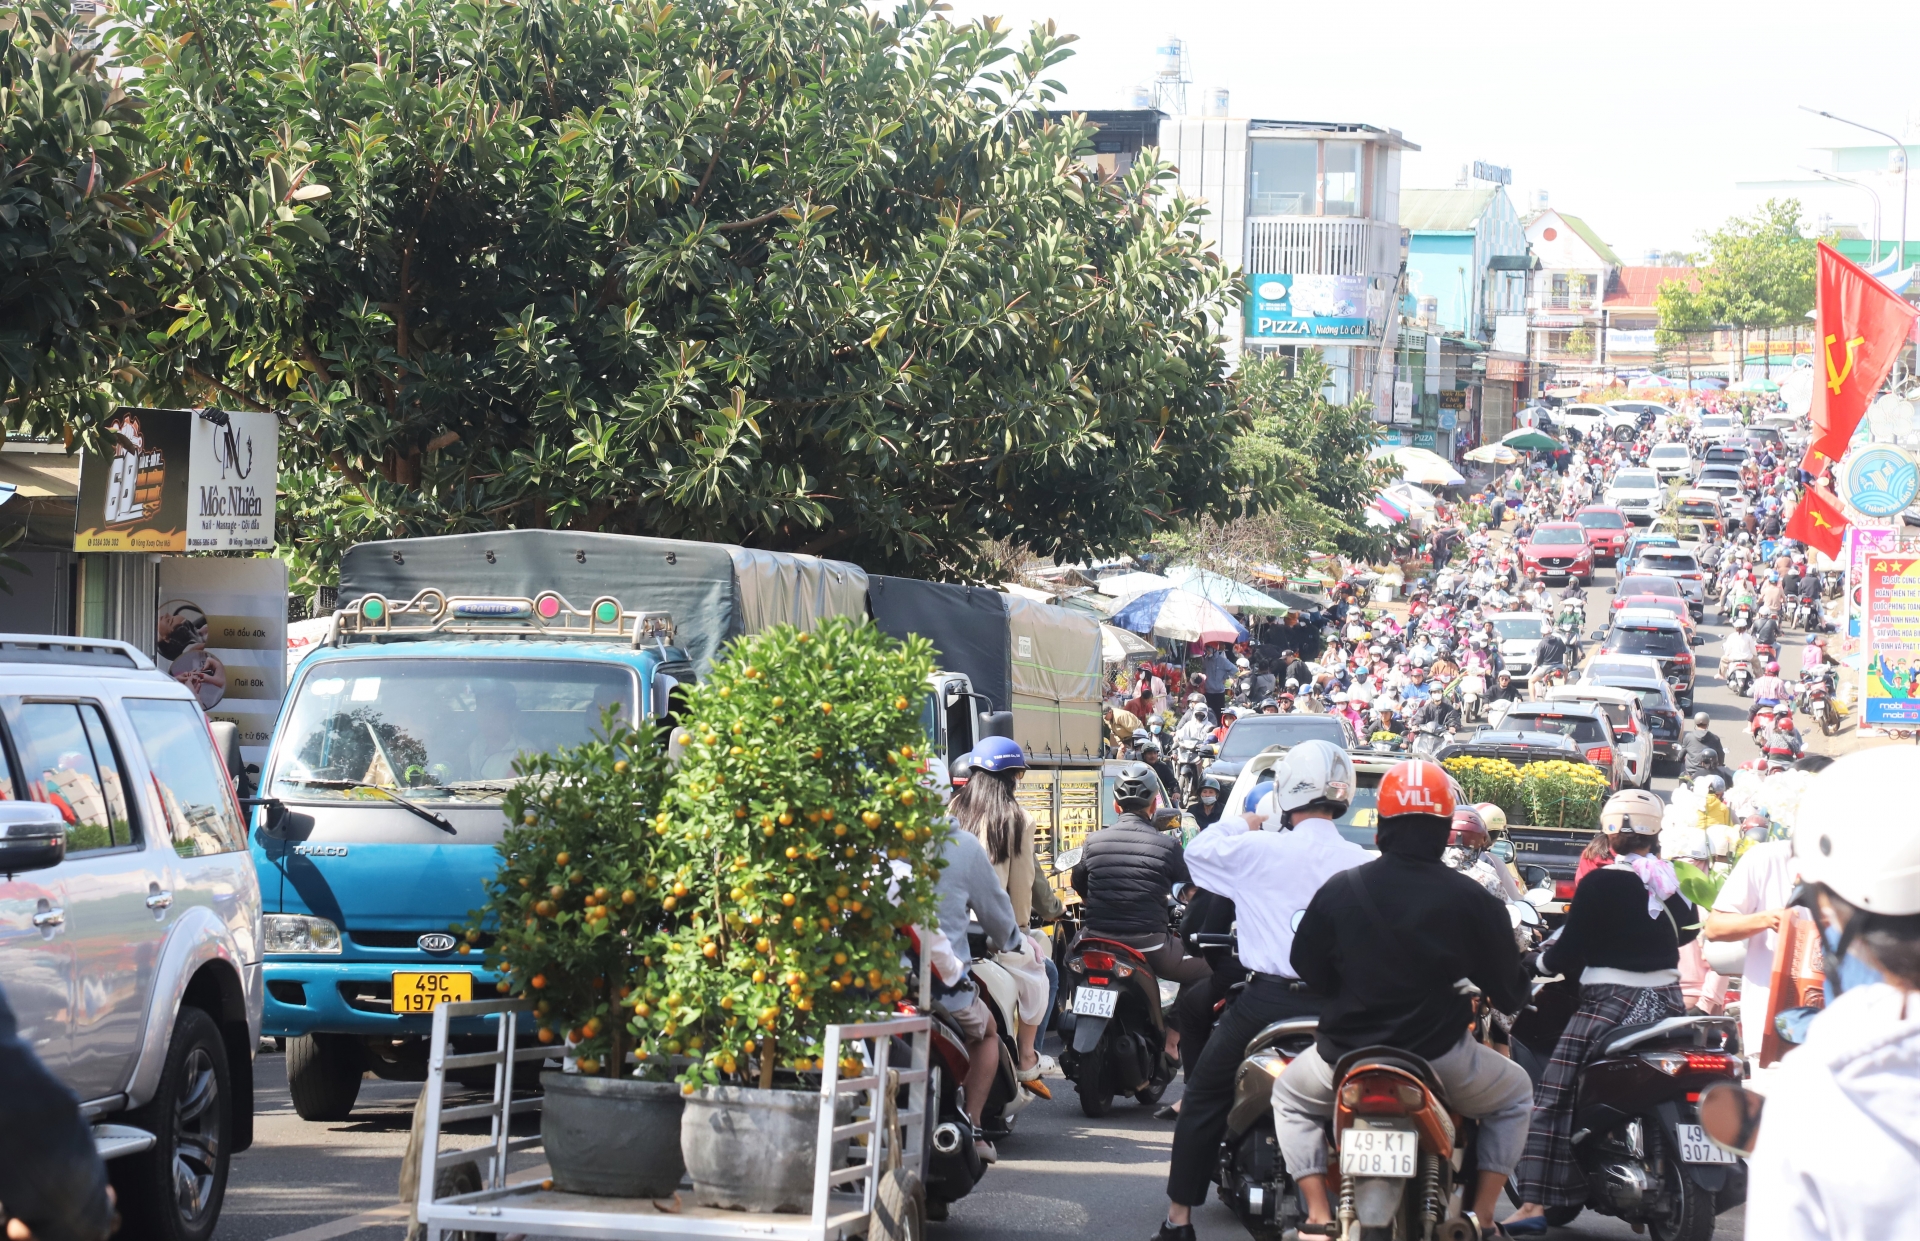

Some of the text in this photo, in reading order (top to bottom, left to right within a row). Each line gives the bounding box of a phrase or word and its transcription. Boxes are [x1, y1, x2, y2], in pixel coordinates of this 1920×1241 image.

[1258, 317, 1311, 335] PIZZA
[1414, 433, 1434, 442] PIZZA
[200, 485, 226, 518] Mộc
[228, 485, 262, 517] Nhiên
[1865, 503, 1887, 514] THÀNH
[202, 520, 212, 530] Nail
[465, 604, 513, 613] FRONTIER
[1873, 600, 1887, 611] QUỐC
[1874, 614, 1881, 623] VÀ
[252, 630, 266, 638] 40k
[1895, 641, 1902, 650] VÀ
[234, 678, 264, 687] Nail 80k
[255, 733, 270, 741] 69k
[1396, 790, 1434, 807] VILL
[293, 845, 348, 857] THACO
[425, 937, 449, 948] KIA
[415, 975, 449, 992] 49C
[1081, 989, 1111, 1003] 49-K1
[1074, 1001, 1111, 1017] 460.54
[1354, 1132, 1404, 1152] 49-K1
[1346, 1153, 1411, 1174] 708.16
